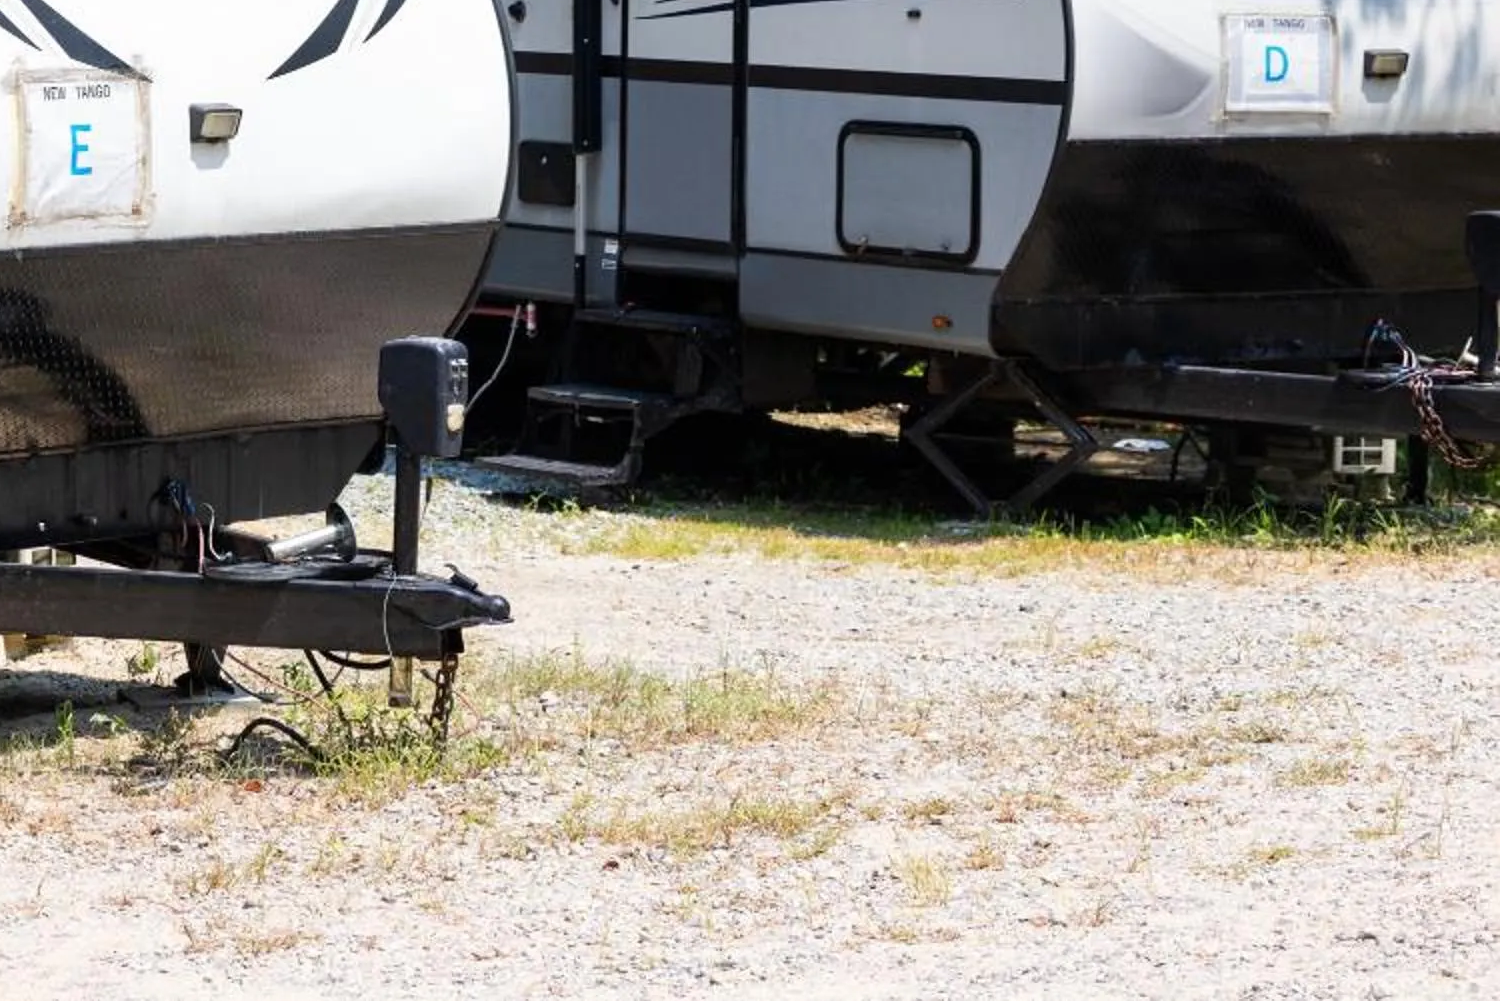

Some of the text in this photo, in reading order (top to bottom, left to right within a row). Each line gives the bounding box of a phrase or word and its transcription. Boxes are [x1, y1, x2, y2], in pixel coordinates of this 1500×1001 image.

[1265, 46, 1289, 82] D
[43, 84, 111, 101] NEW TANGO
[70, 124, 92, 176] E
